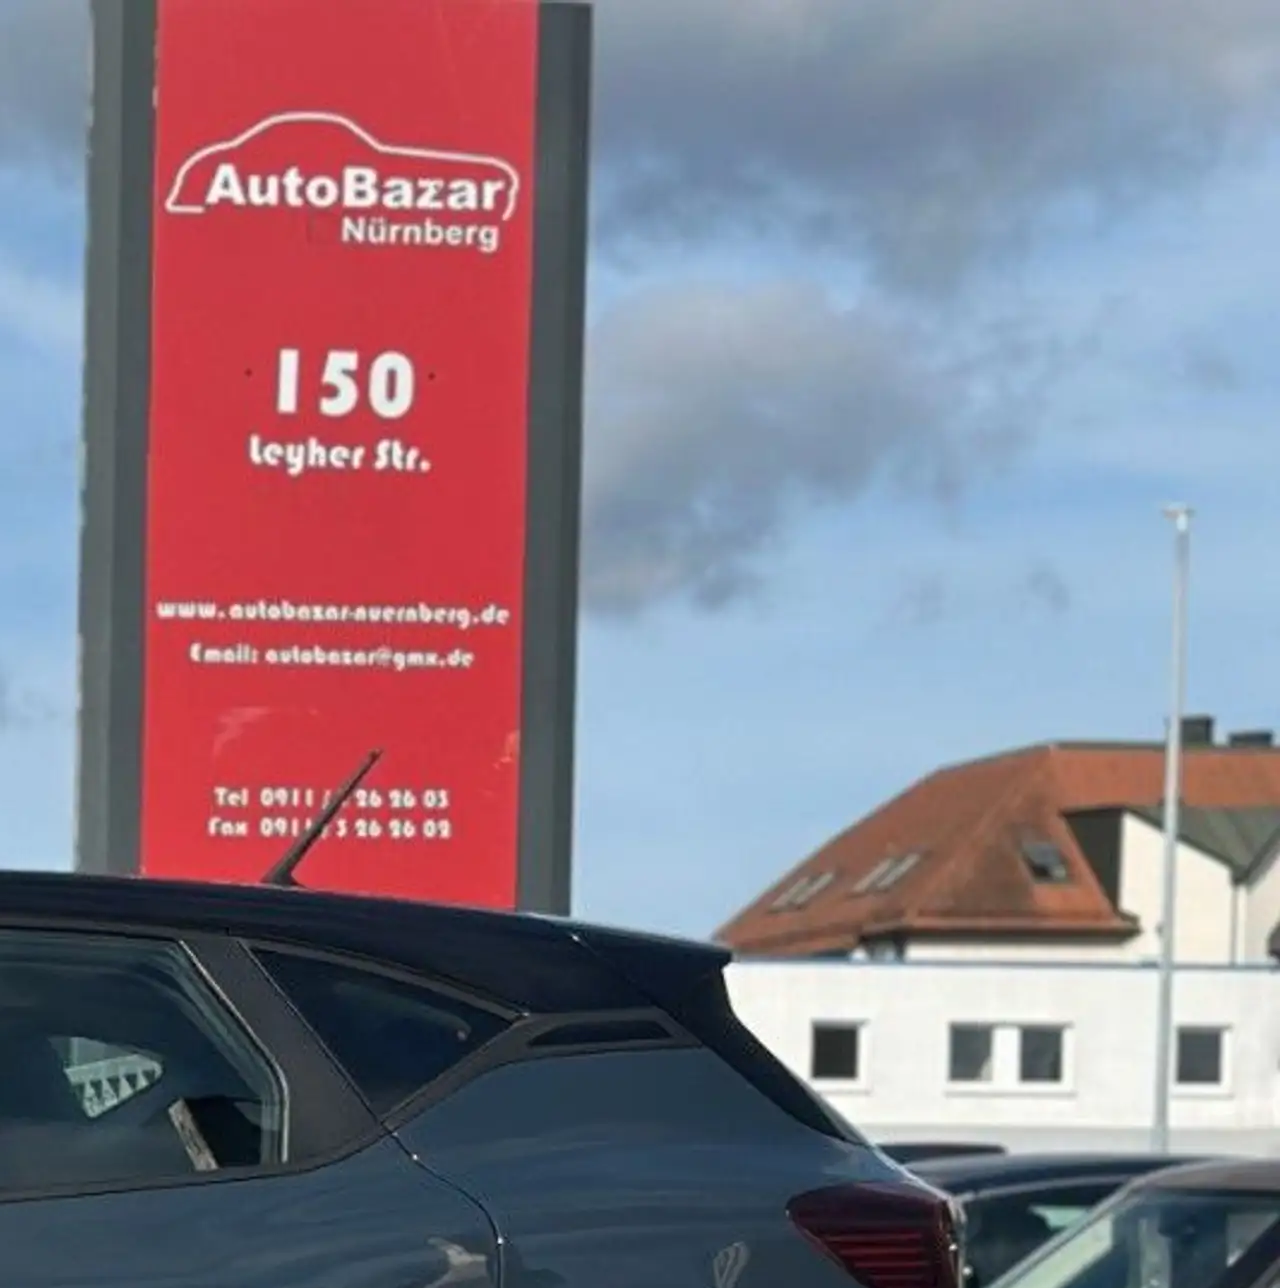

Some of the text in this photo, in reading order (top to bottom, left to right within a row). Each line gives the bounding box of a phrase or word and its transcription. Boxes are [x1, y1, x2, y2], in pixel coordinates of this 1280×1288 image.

[205, 163, 505, 211] AutoBazar
[341, 216, 499, 253] Nürnberg
[277, 348, 415, 419] 150
[249, 434, 431, 476] Leyher Str.
[189, 642, 474, 672] Email: autobazar@gmx.de
[213, 786, 249, 808] Tel
[259, 787, 314, 808] 0911
[354, 788, 383, 808] 26
[388, 788, 417, 809] 26
[207, 816, 249, 837] Fax
[354, 818, 383, 838] 26
[388, 818, 417, 839] 26
